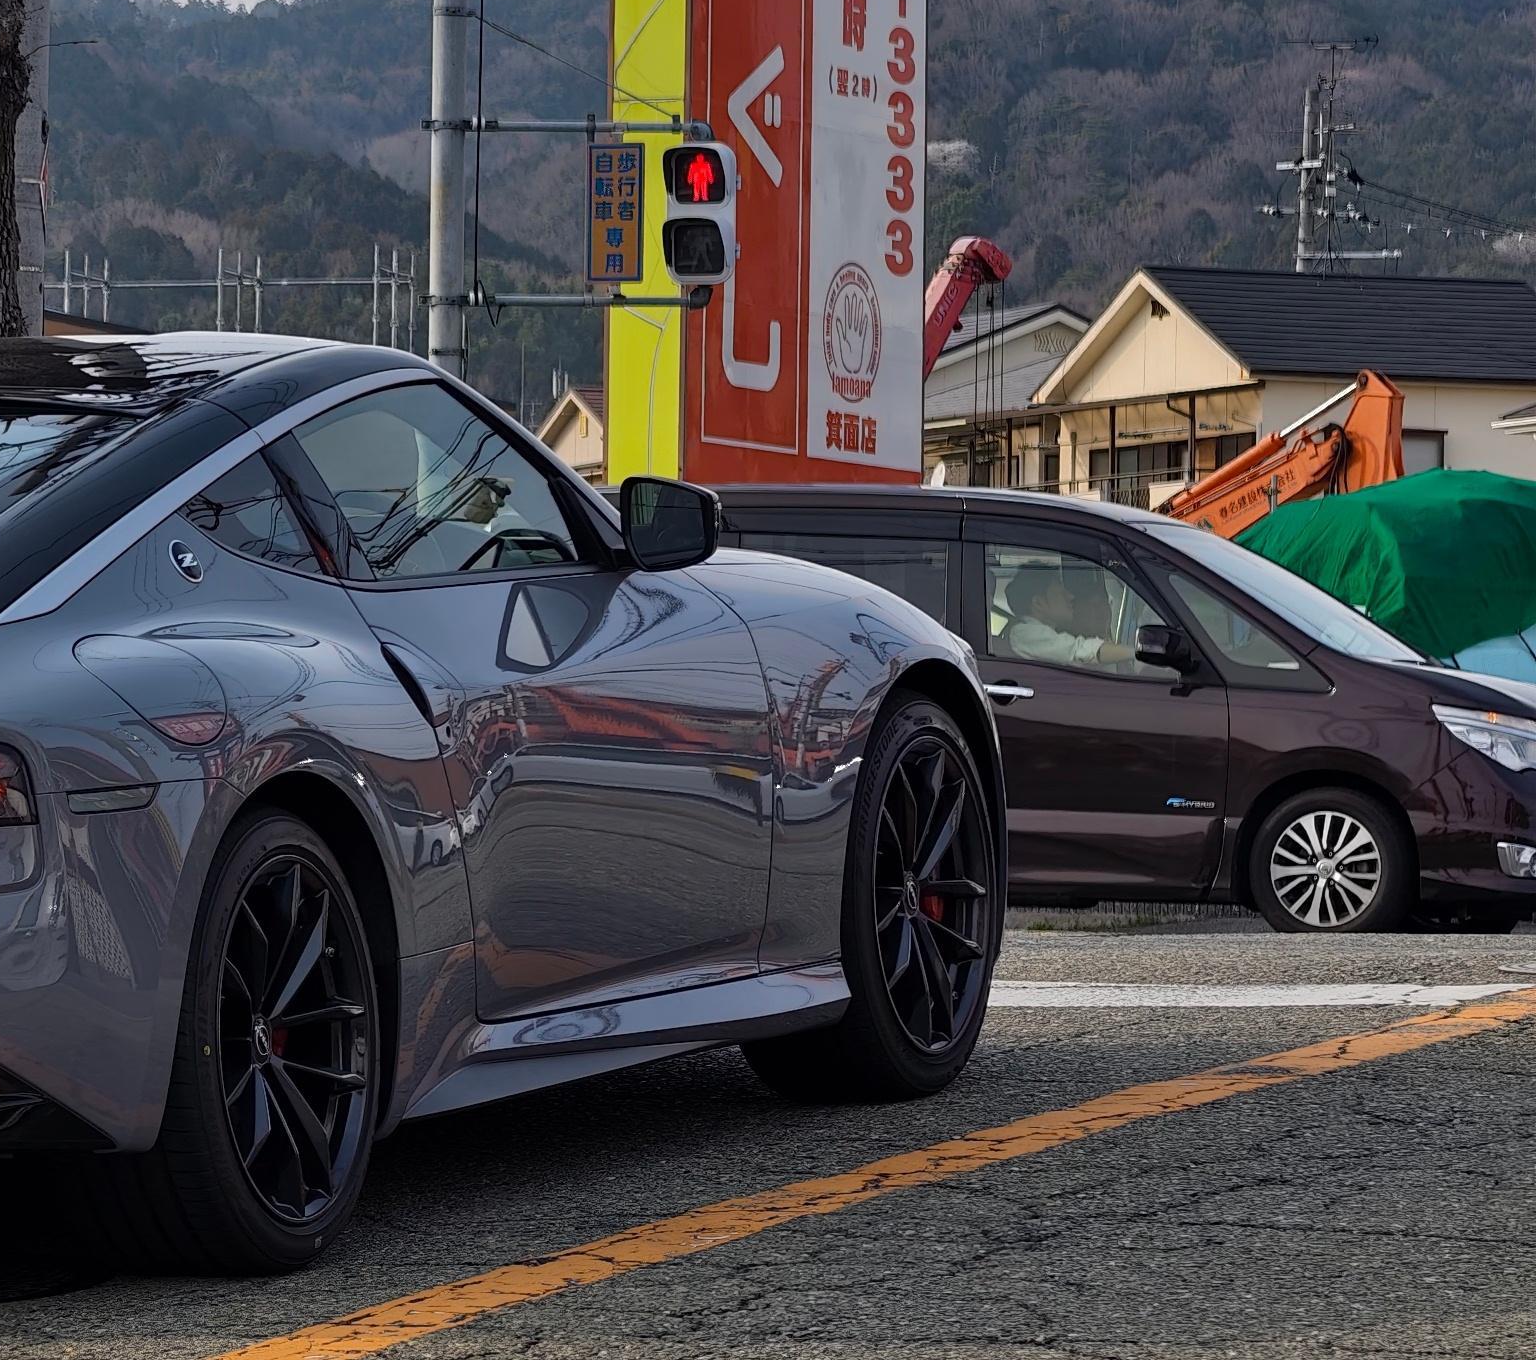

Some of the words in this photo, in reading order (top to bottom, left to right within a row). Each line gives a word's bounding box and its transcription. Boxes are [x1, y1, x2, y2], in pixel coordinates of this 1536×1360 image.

[595, 152, 614, 221] 自転車
[617, 152, 636, 221] 歩行者
[825, 409, 877, 455] 箕面店
